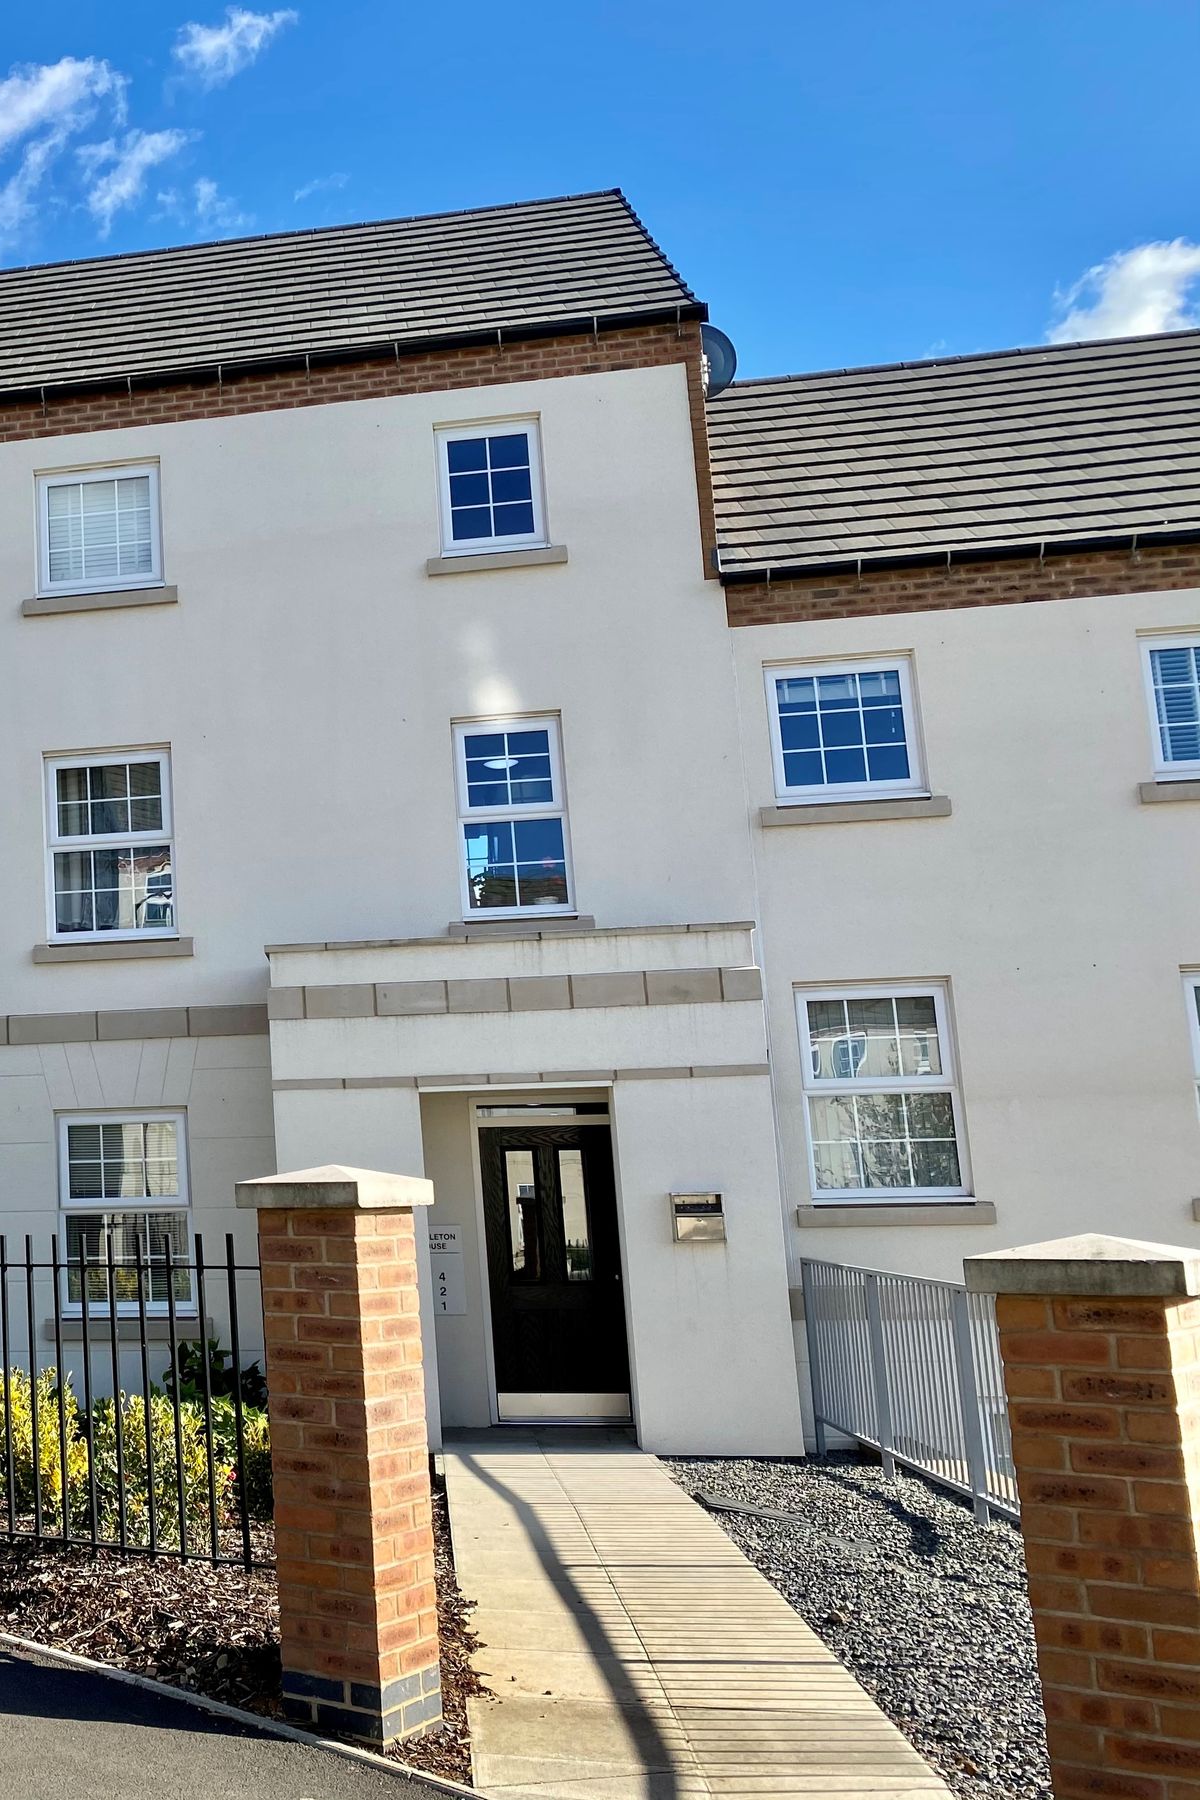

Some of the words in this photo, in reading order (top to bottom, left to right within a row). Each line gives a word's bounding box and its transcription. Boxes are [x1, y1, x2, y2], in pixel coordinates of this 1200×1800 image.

[428, 1242, 447, 1250] USE
[439, 1272, 446, 1281] 4
[440, 1286, 447, 1296] 2
[441, 1301, 447, 1311] 1
